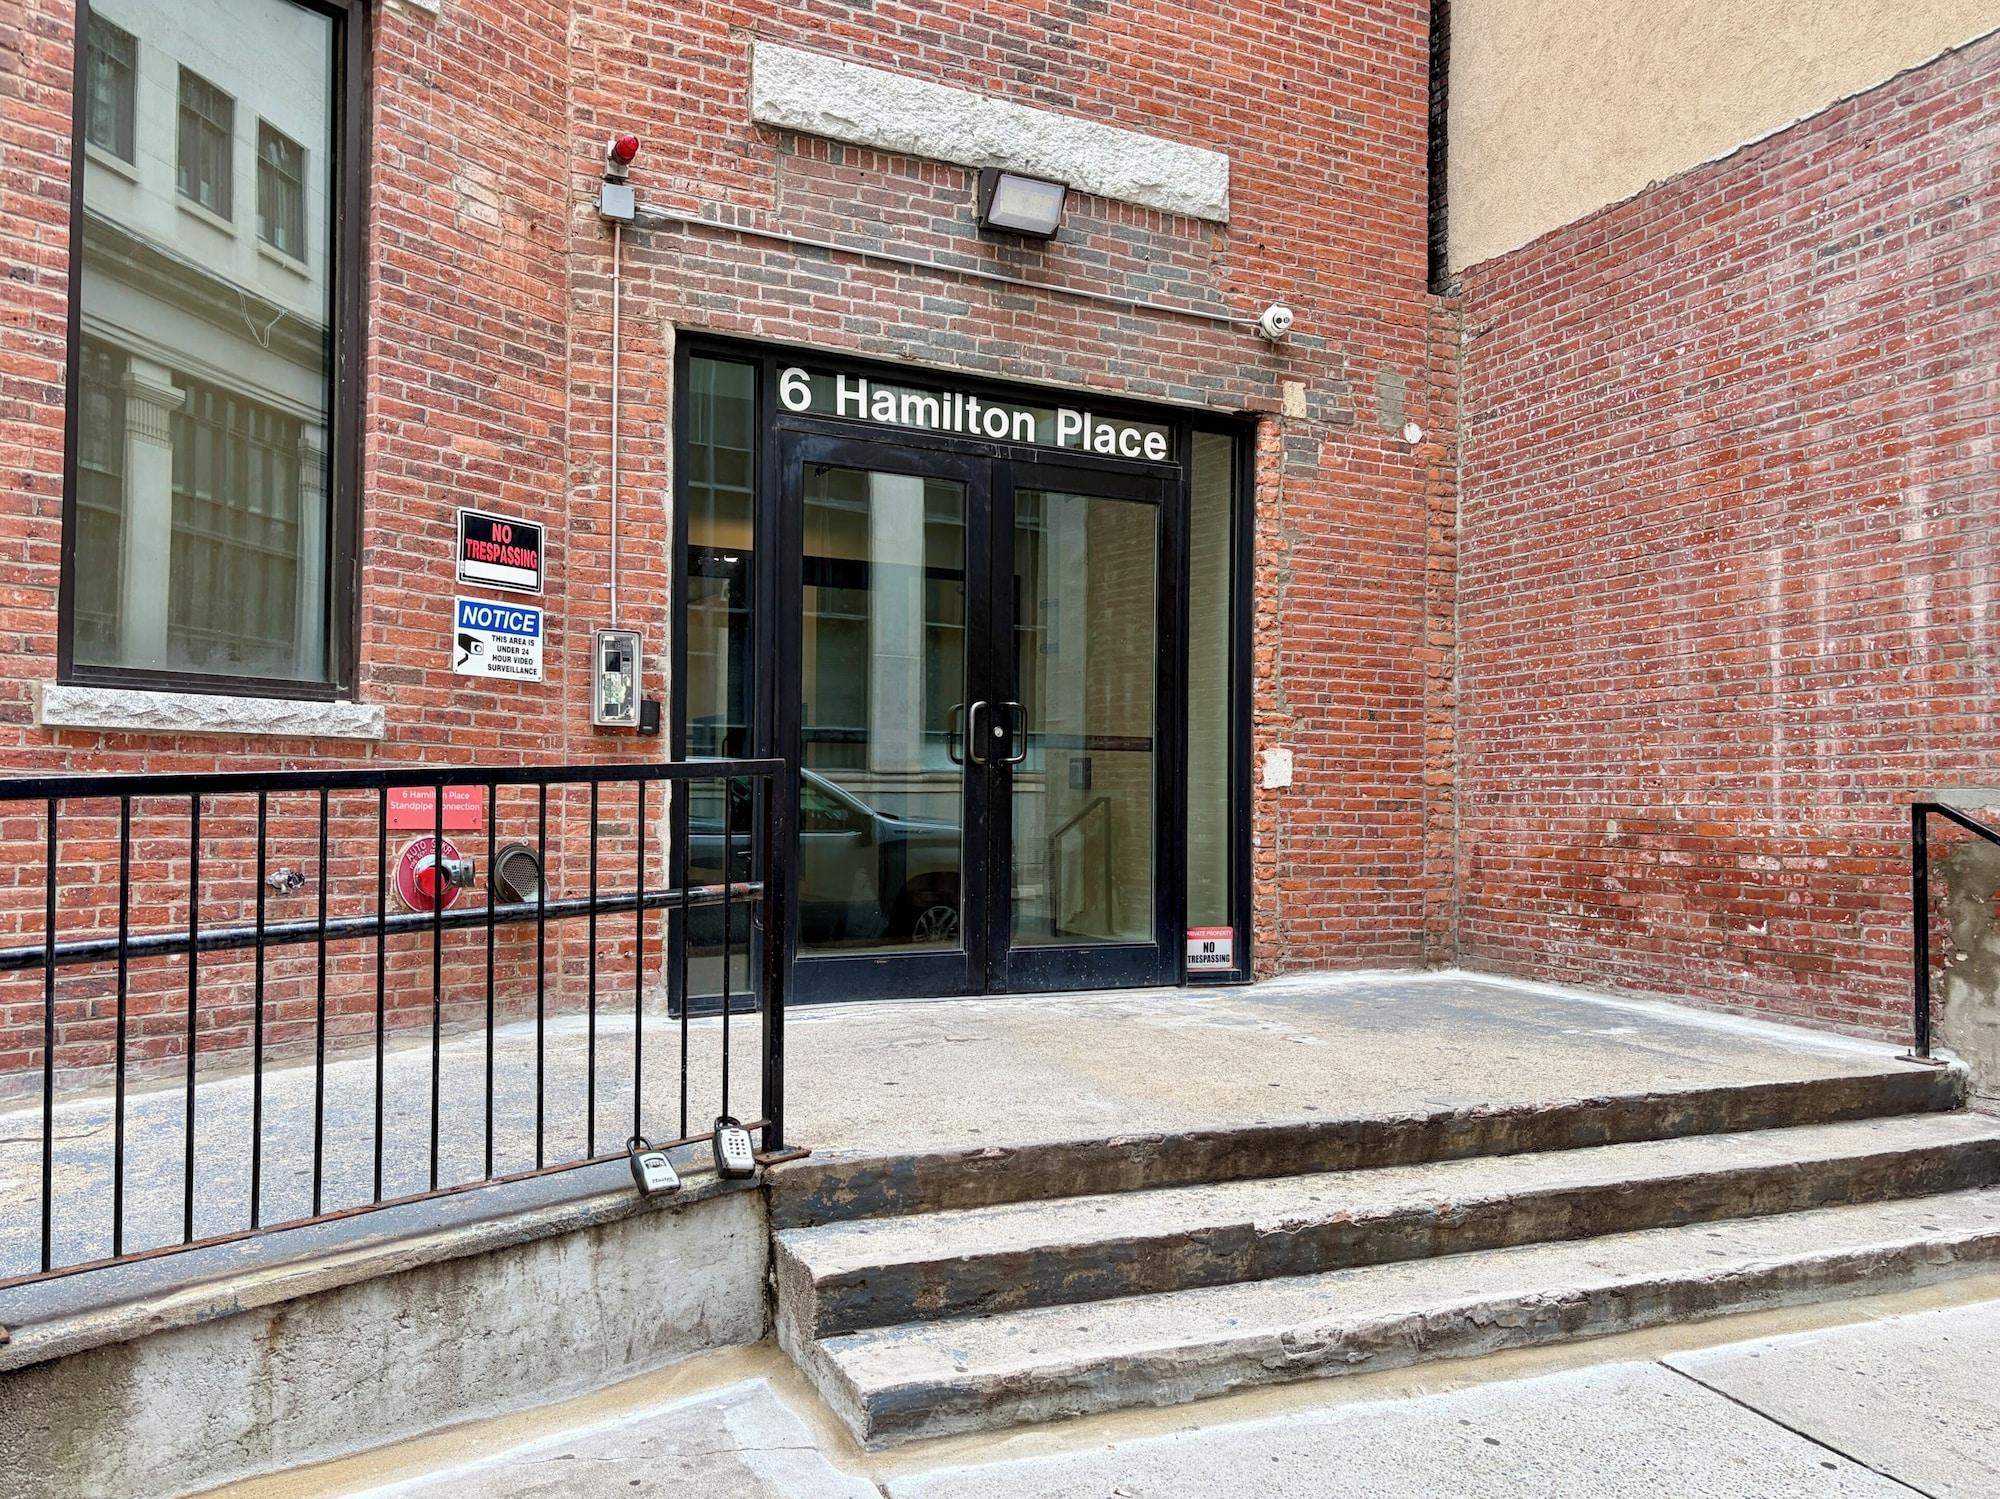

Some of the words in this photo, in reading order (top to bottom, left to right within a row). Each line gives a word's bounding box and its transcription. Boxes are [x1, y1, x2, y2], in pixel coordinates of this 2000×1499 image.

[779, 367, 812, 412] 6
[836, 374, 1036, 443] Hamilton
[1057, 407, 1168, 461] Place
[492, 523, 512, 544] NO
[466, 538, 537, 569] TRESPASSING
[462, 605, 536, 633] NOTICE
[492, 634, 507, 643] THIS
[509, 637, 527, 646] AREA
[528, 639, 535, 647] IS
[497, 645, 520, 655] UNDER
[521, 648, 530, 656] 24
[492, 654, 512, 663] HOUR
[513, 656, 534, 666] VIDEO
[487, 663, 538, 676] SURVEILLANCE
[402, 791, 408, 799] 6
[449, 791, 470, 800] Place
[391, 801, 433, 811] Standpipe
[442, 802, 480, 811] onnection
[406, 841, 427, 862] AUTO
[431, 839, 452, 855] SKR
[1203, 941, 1215, 953] NO
[1188, 954, 1230, 963] TRESPASSING
